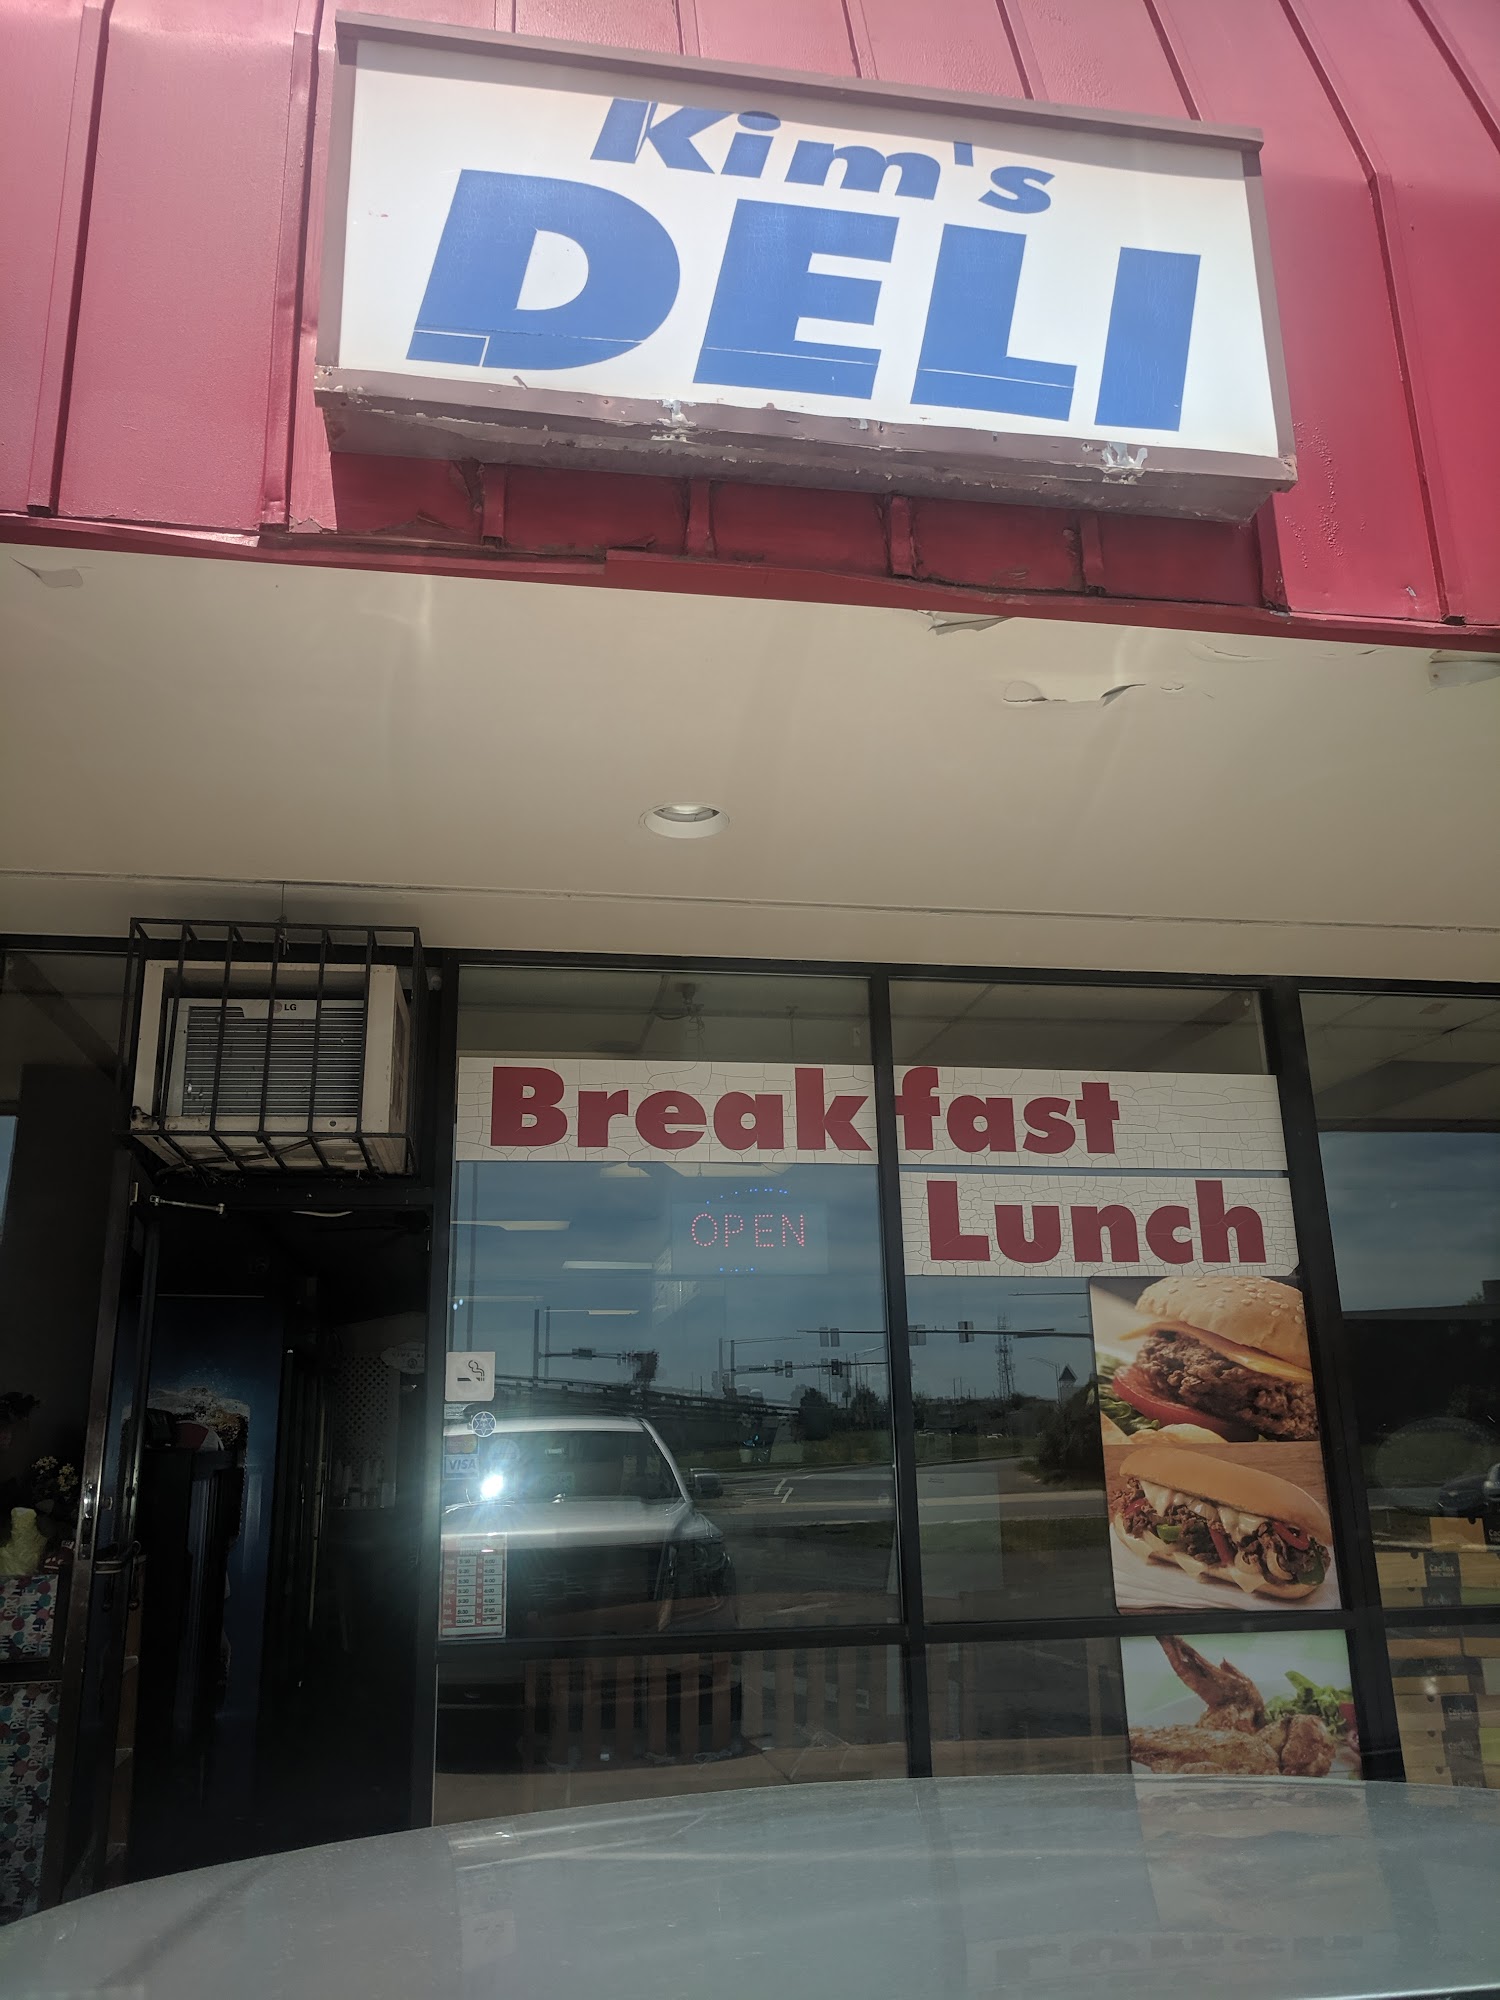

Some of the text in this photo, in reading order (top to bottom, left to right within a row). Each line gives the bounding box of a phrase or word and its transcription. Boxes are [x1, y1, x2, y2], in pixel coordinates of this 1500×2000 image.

[590, 98, 1056, 214] Kim's
[405, 168, 1201, 431] DELI
[284, 1003, 297, 1011] LG
[690, 1213, 806, 1248] OPEN
[926, 1179, 1267, 1265] Lunch
[449, 1459, 477, 1470] VISA
